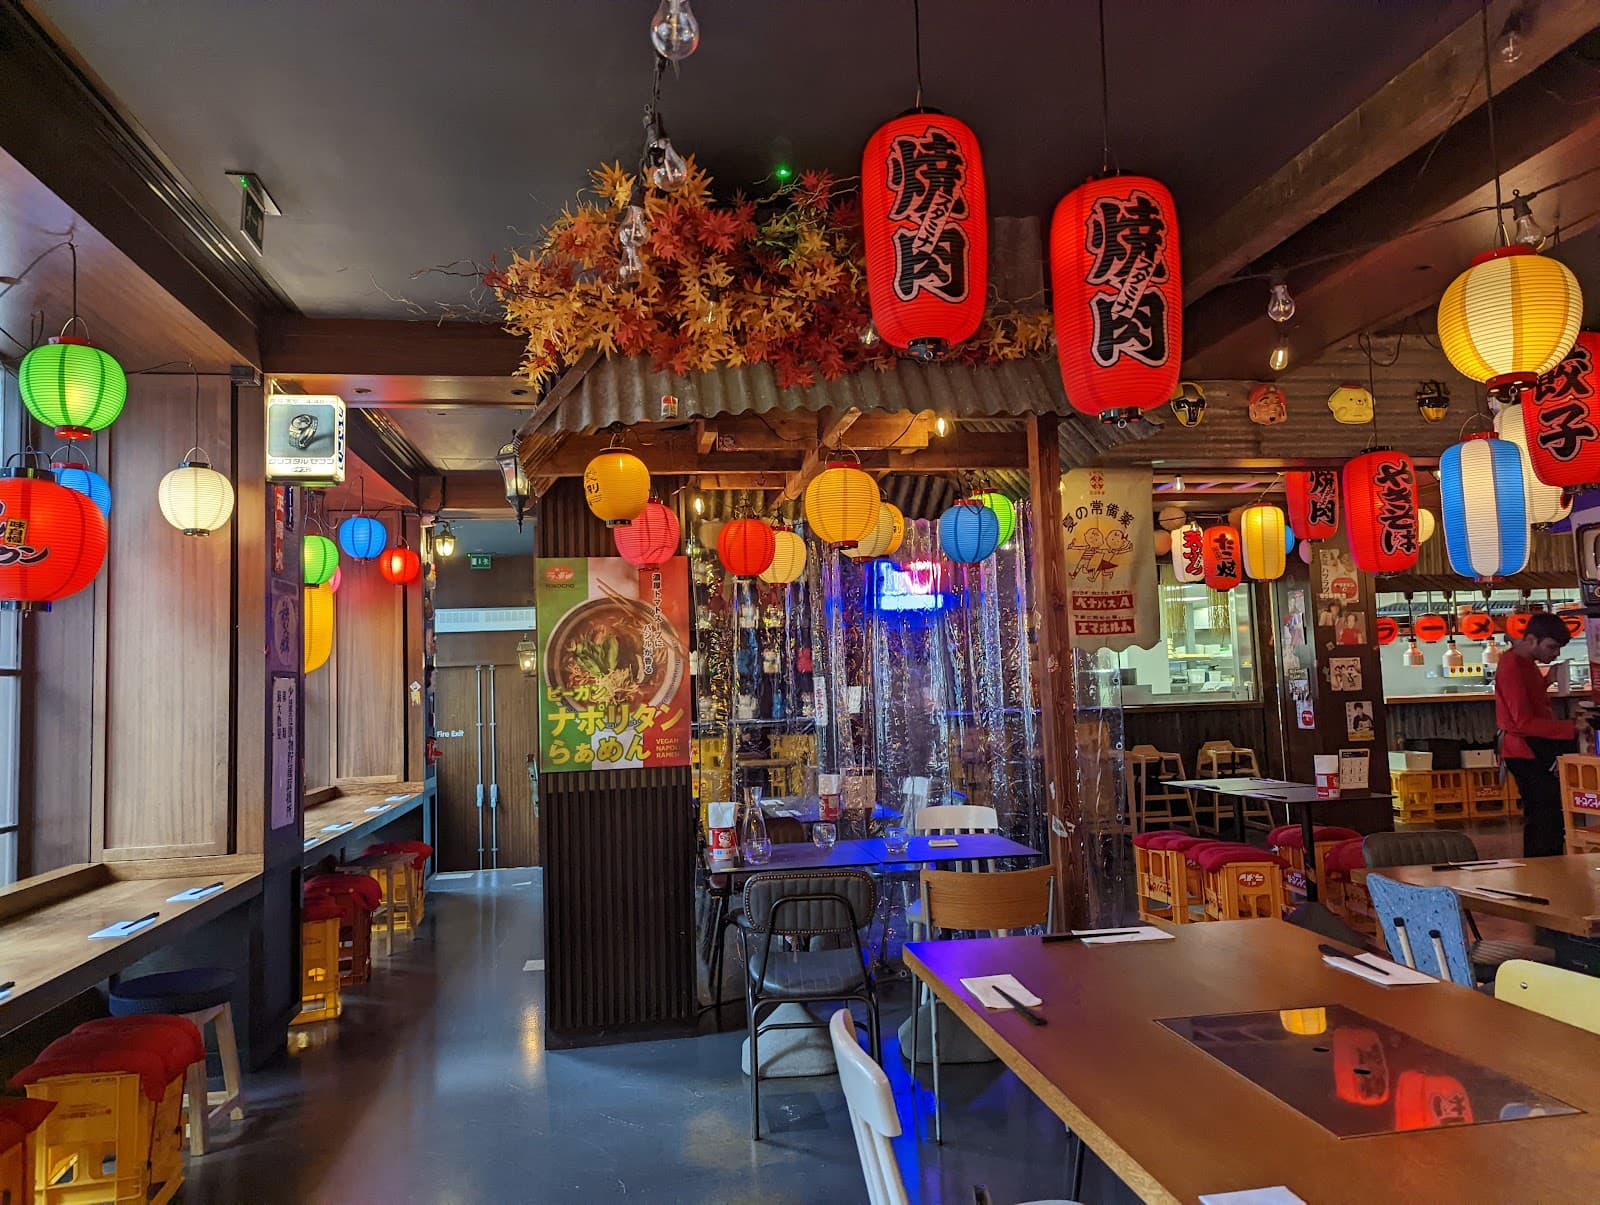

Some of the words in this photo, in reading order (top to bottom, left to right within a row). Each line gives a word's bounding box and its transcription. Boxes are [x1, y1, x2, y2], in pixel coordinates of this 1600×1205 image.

[887, 126, 969, 302] 焼肉
[1085, 190, 1170, 367] 焼肉
[1534, 344, 1598, 461] 餃子
[1062, 499, 1135, 534] 夏の常備薬
[436, 730, 449, 738] Fire
[451, 729, 464, 738] Exit
[548, 702, 684, 737] ナポリタン
[548, 734, 651, 765] らぁめん
